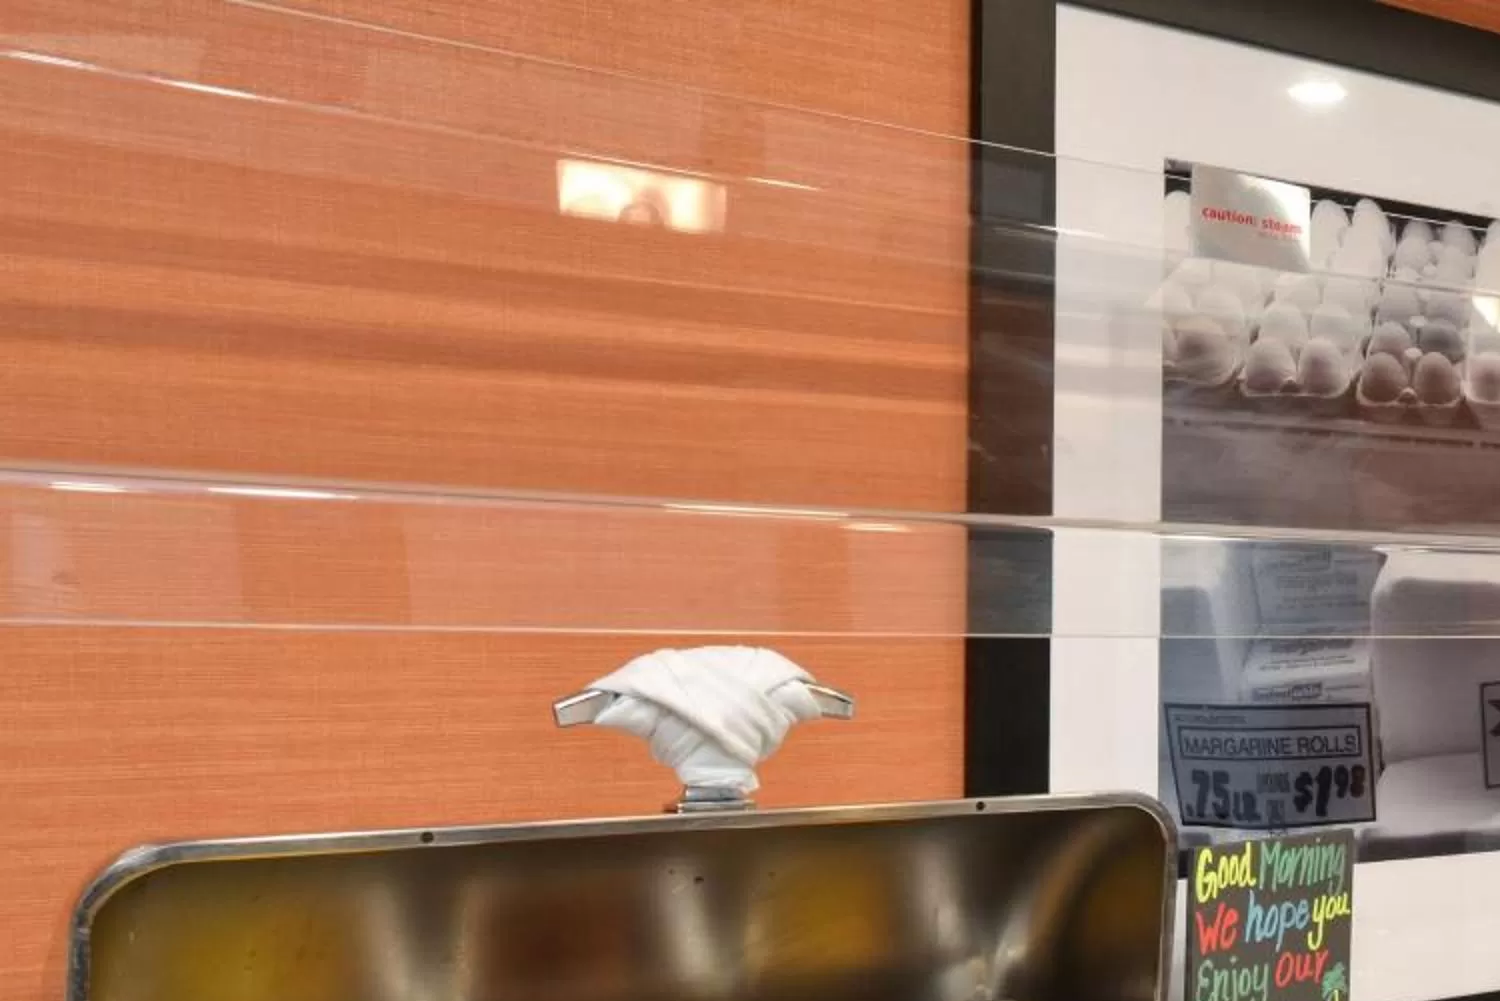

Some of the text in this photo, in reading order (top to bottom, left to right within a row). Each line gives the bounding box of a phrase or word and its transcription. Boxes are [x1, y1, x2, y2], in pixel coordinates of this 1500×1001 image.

[1183, 734, 1357, 756] MARGARINE ROLLS
[1196, 837, 1345, 903] Good Morning
[1196, 889, 1350, 955] We hope you
